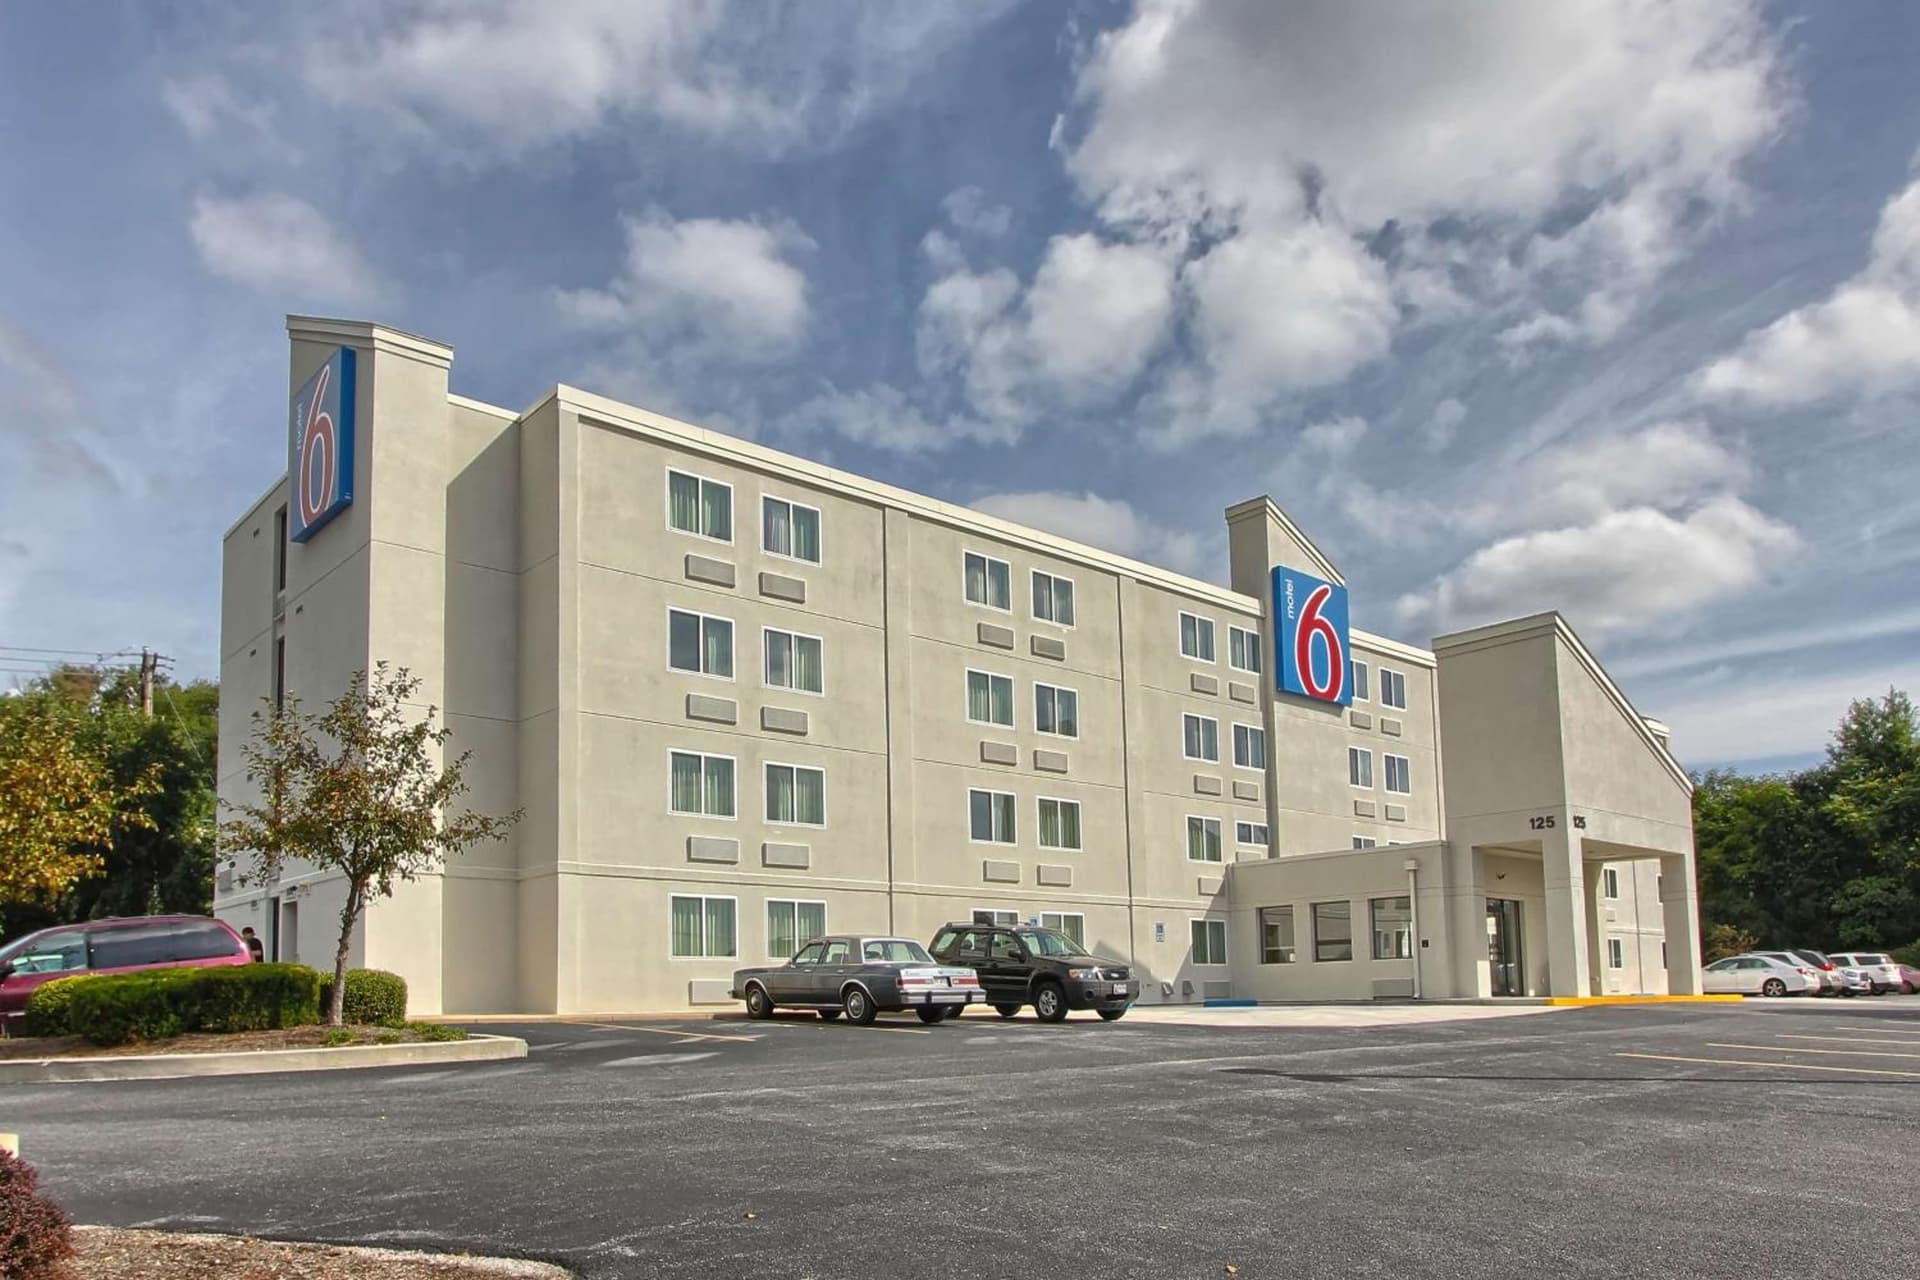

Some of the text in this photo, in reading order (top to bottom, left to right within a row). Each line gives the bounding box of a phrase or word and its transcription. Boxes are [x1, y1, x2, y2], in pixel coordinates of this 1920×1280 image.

[300, 364, 335, 528] 6
[1285, 579, 1295, 620] motel
[1295, 584, 1344, 702] 6
[1529, 816, 1555, 830] 125
